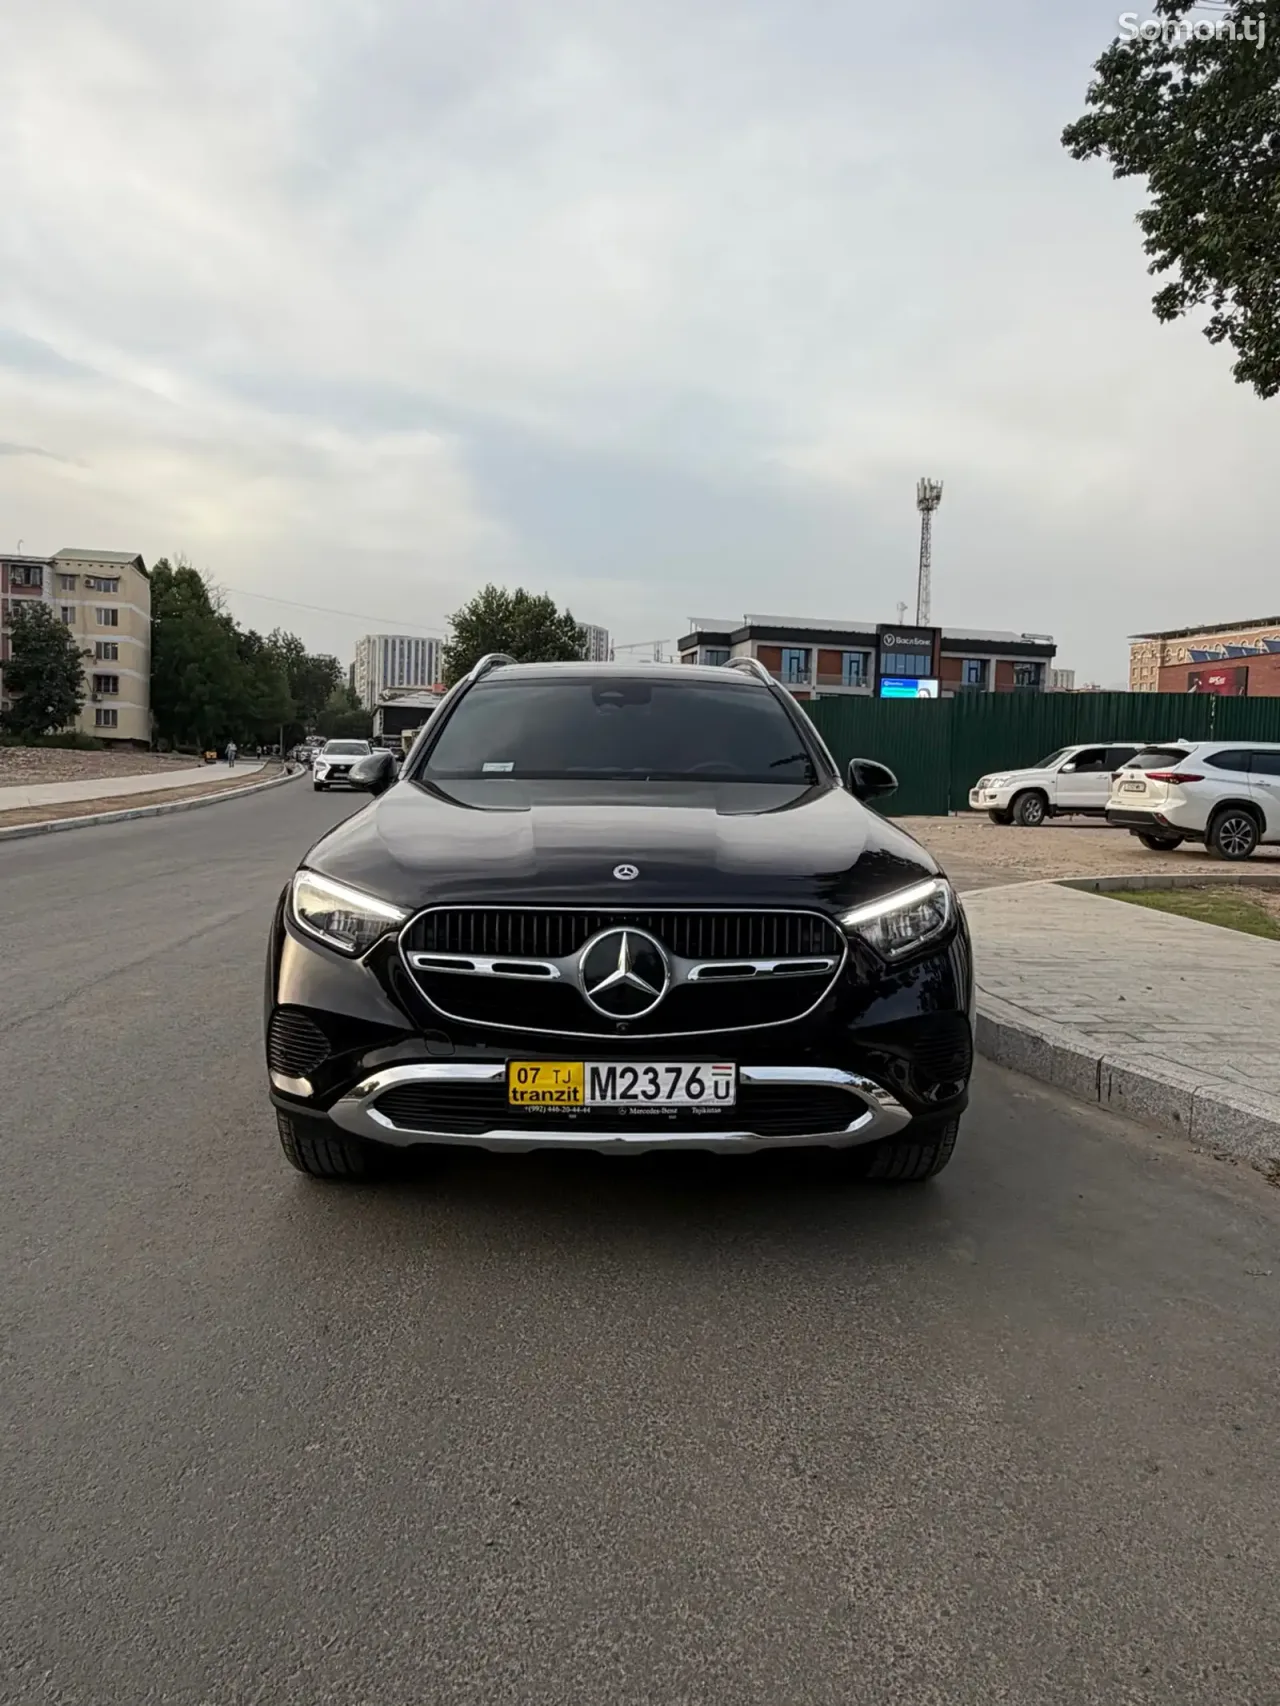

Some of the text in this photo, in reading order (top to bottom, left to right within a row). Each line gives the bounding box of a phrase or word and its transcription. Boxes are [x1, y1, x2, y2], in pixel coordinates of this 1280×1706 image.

[517, 1067, 571, 1084] 07 TJ
[590, 1066, 730, 1101] M2376 U
[511, 1086, 579, 1103] tranzit
[629, 1107, 678, 1115] Mercedes-Benz
